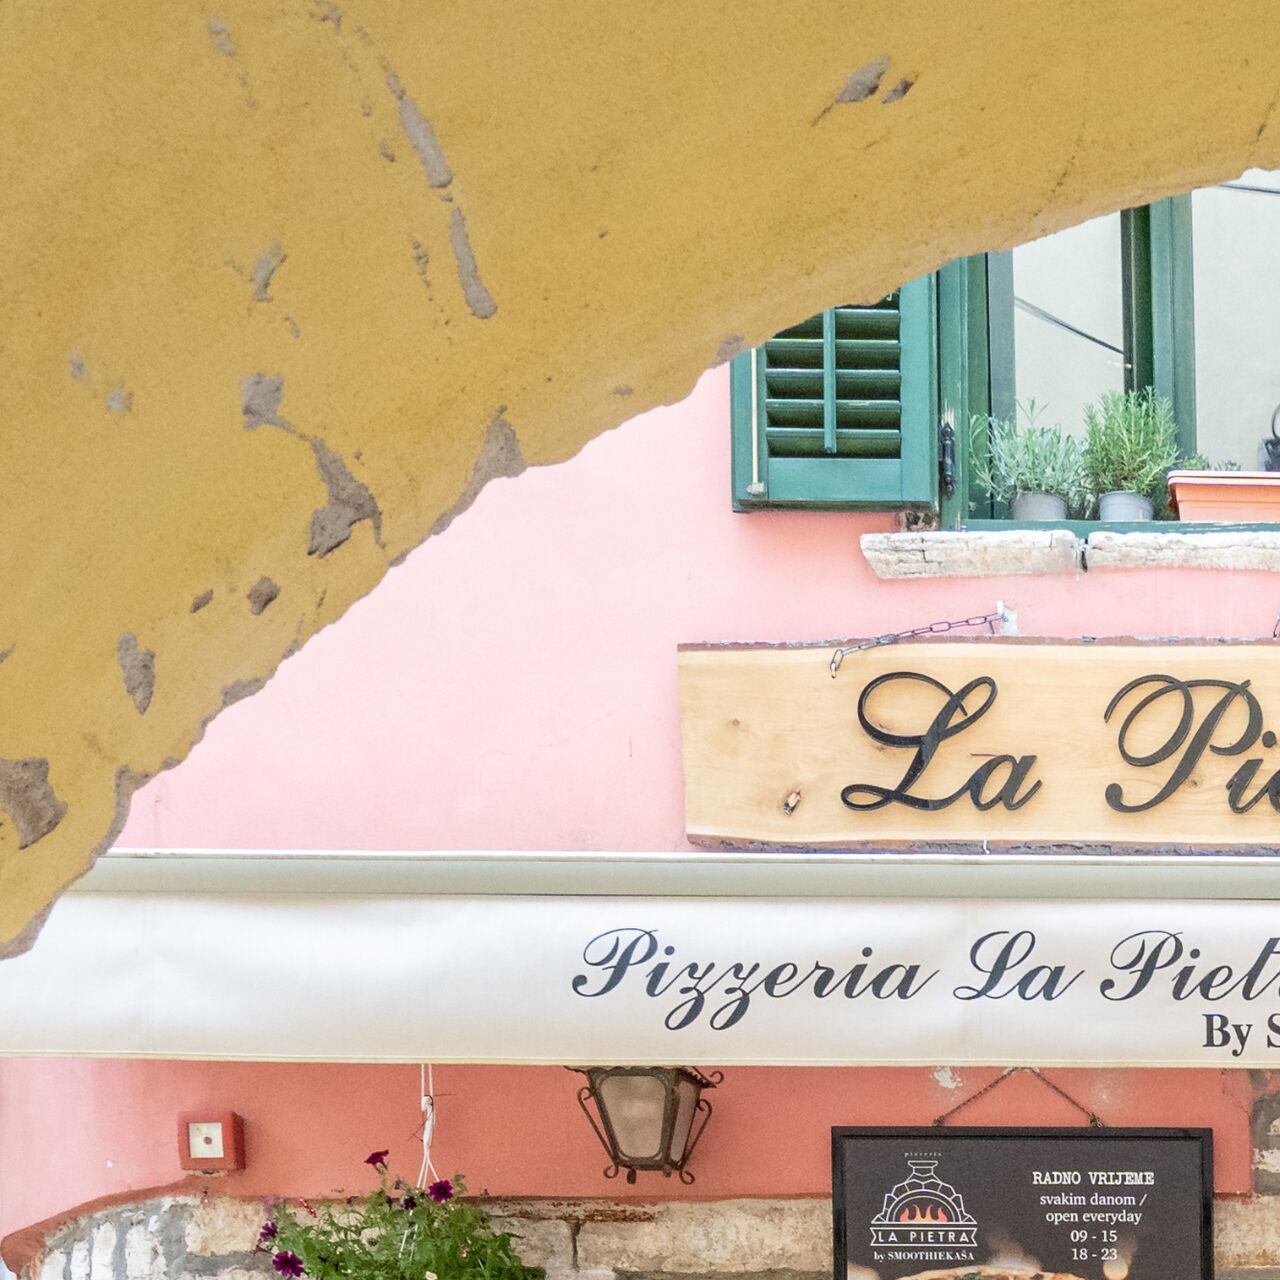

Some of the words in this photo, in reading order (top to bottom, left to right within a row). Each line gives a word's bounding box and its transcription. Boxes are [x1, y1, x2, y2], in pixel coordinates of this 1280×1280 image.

[841, 671, 1043, 813] La
[571, 926, 940, 1032] Pizzeria
[953, 929, 1086, 1003] La
[1202, 1011, 1252, 1057] By
[1032, 1171, 1081, 1185] RADNO
[1088, 1171, 1155, 1186] VRIJEME
[1039, 1193, 1086, 1206] svakim
[1090, 1193, 1136, 1206] danom
[1046, 1212, 1079, 1226] open
[1082, 1209, 1142, 1226] everyday
[878, 1231, 898, 1243] LA
[909, 1231, 970, 1243] PIETRA
[1070, 1230, 1088, 1243] 09
[1101, 1230, 1118, 1243] 15
[873, 1251, 885, 1262] by
[887, 1250, 975, 1261] SMOOTHIEKAŠA
[1071, 1248, 1089, 1261] 18
[1100, 1248, 1118, 1261] 23
